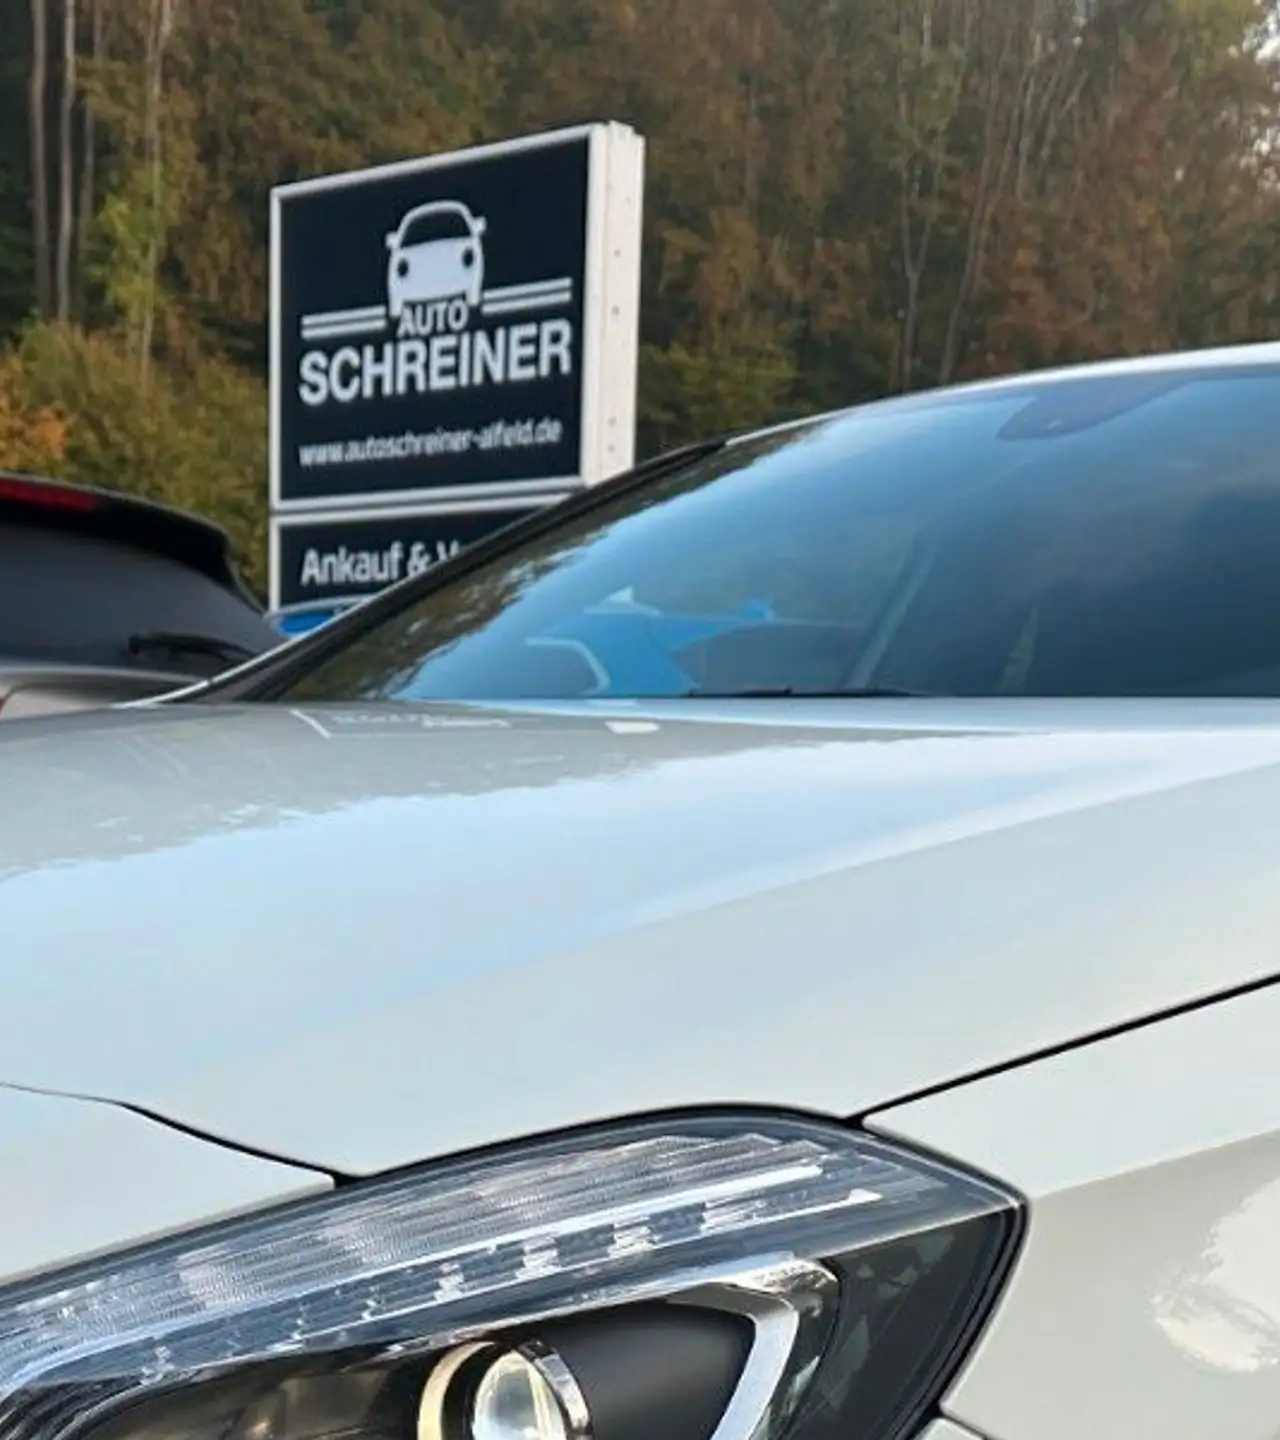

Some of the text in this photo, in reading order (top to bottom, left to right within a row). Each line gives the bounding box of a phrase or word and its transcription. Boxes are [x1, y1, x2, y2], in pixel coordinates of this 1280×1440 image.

[397, 299, 469, 338] AUTO
[299, 318, 572, 406] SCHREINER
[299, 416, 563, 468] www.autoschreiner-alfeld.de
[300, 540, 403, 587] Ankauf
[407, 541, 431, 577] &
